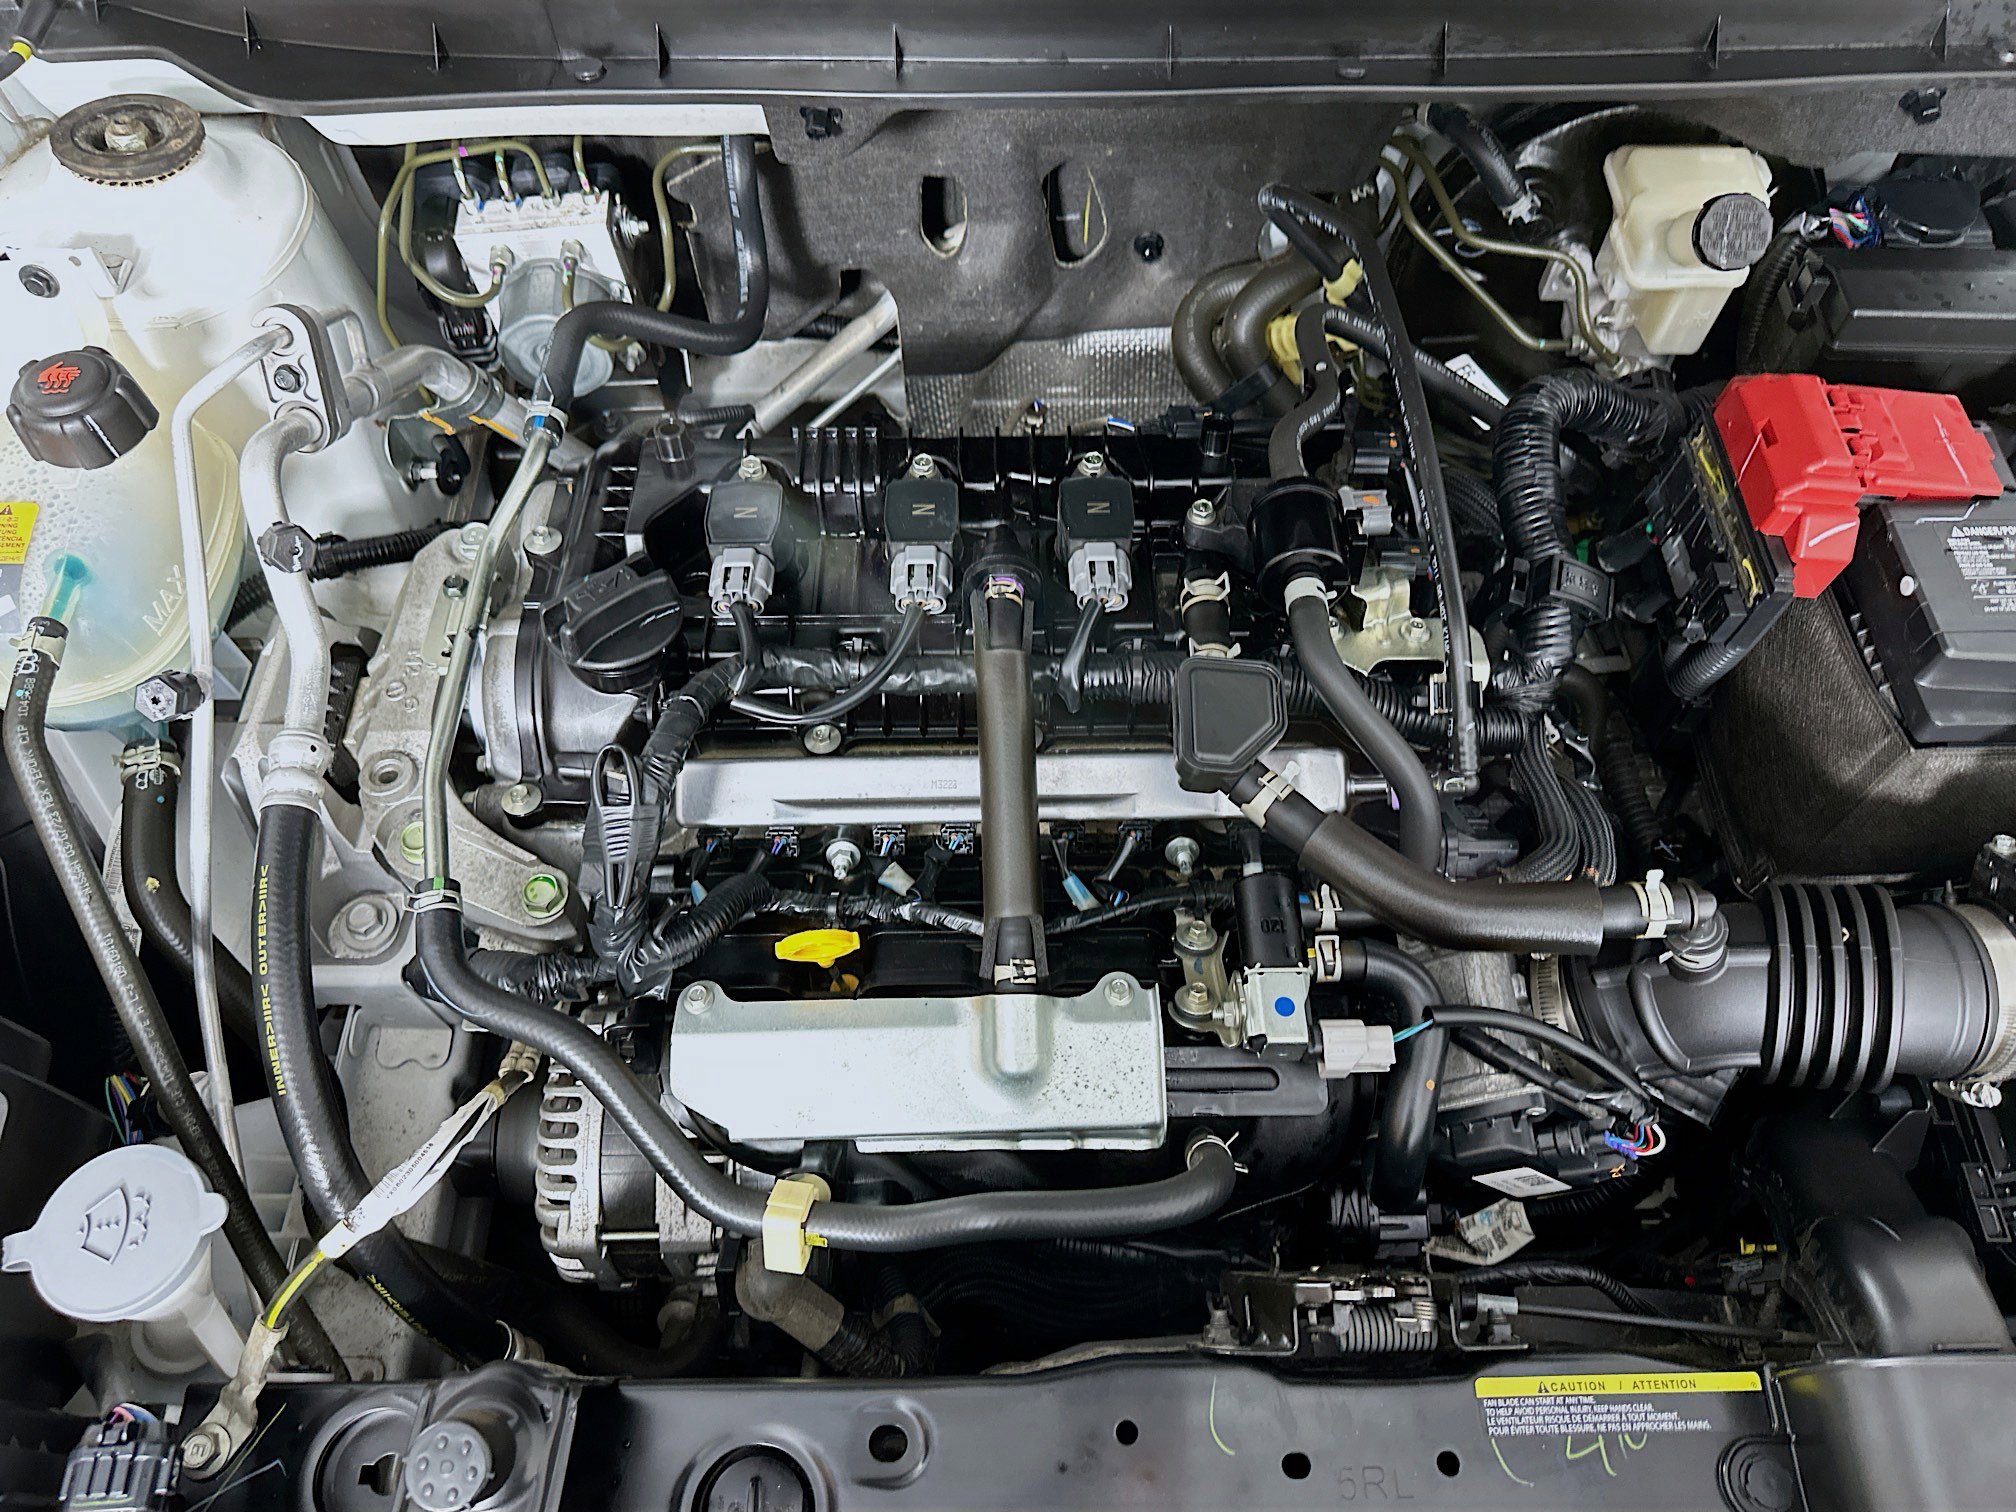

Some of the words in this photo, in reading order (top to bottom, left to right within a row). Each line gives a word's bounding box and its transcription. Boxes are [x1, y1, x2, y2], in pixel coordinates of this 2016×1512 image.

[142, 564, 187, 637] MAX
[1550, 1381, 1606, 1392] CAUTION
[1632, 1378, 1697, 1390] ATTENTION
[1498, 1398, 1519, 1407] BLADE
[1520, 1397, 1534, 1406] CAN
[1535, 1396, 1555, 1406] START
[1485, 1407, 1496, 1417] TO
[1496, 1406, 1513, 1416] HELP
[1513, 1406, 1535, 1416] AVOID
[1535, 1405, 1569, 1415] PERSONAL
[1486, 1417, 1496, 1426] LE
[1572, 1414, 1582, 1423] DE
[1627, 1411, 1646, 1421] TOUT
[1488, 1426, 1510, 1436] POUR
[1536, 1425, 1559, 1435] TOUTE
[1608, 1422, 1621, 1432] PAS
[1621, 1422, 1632, 1432] EN
[1632, 1421, 1674, 1432] APPROCHER
